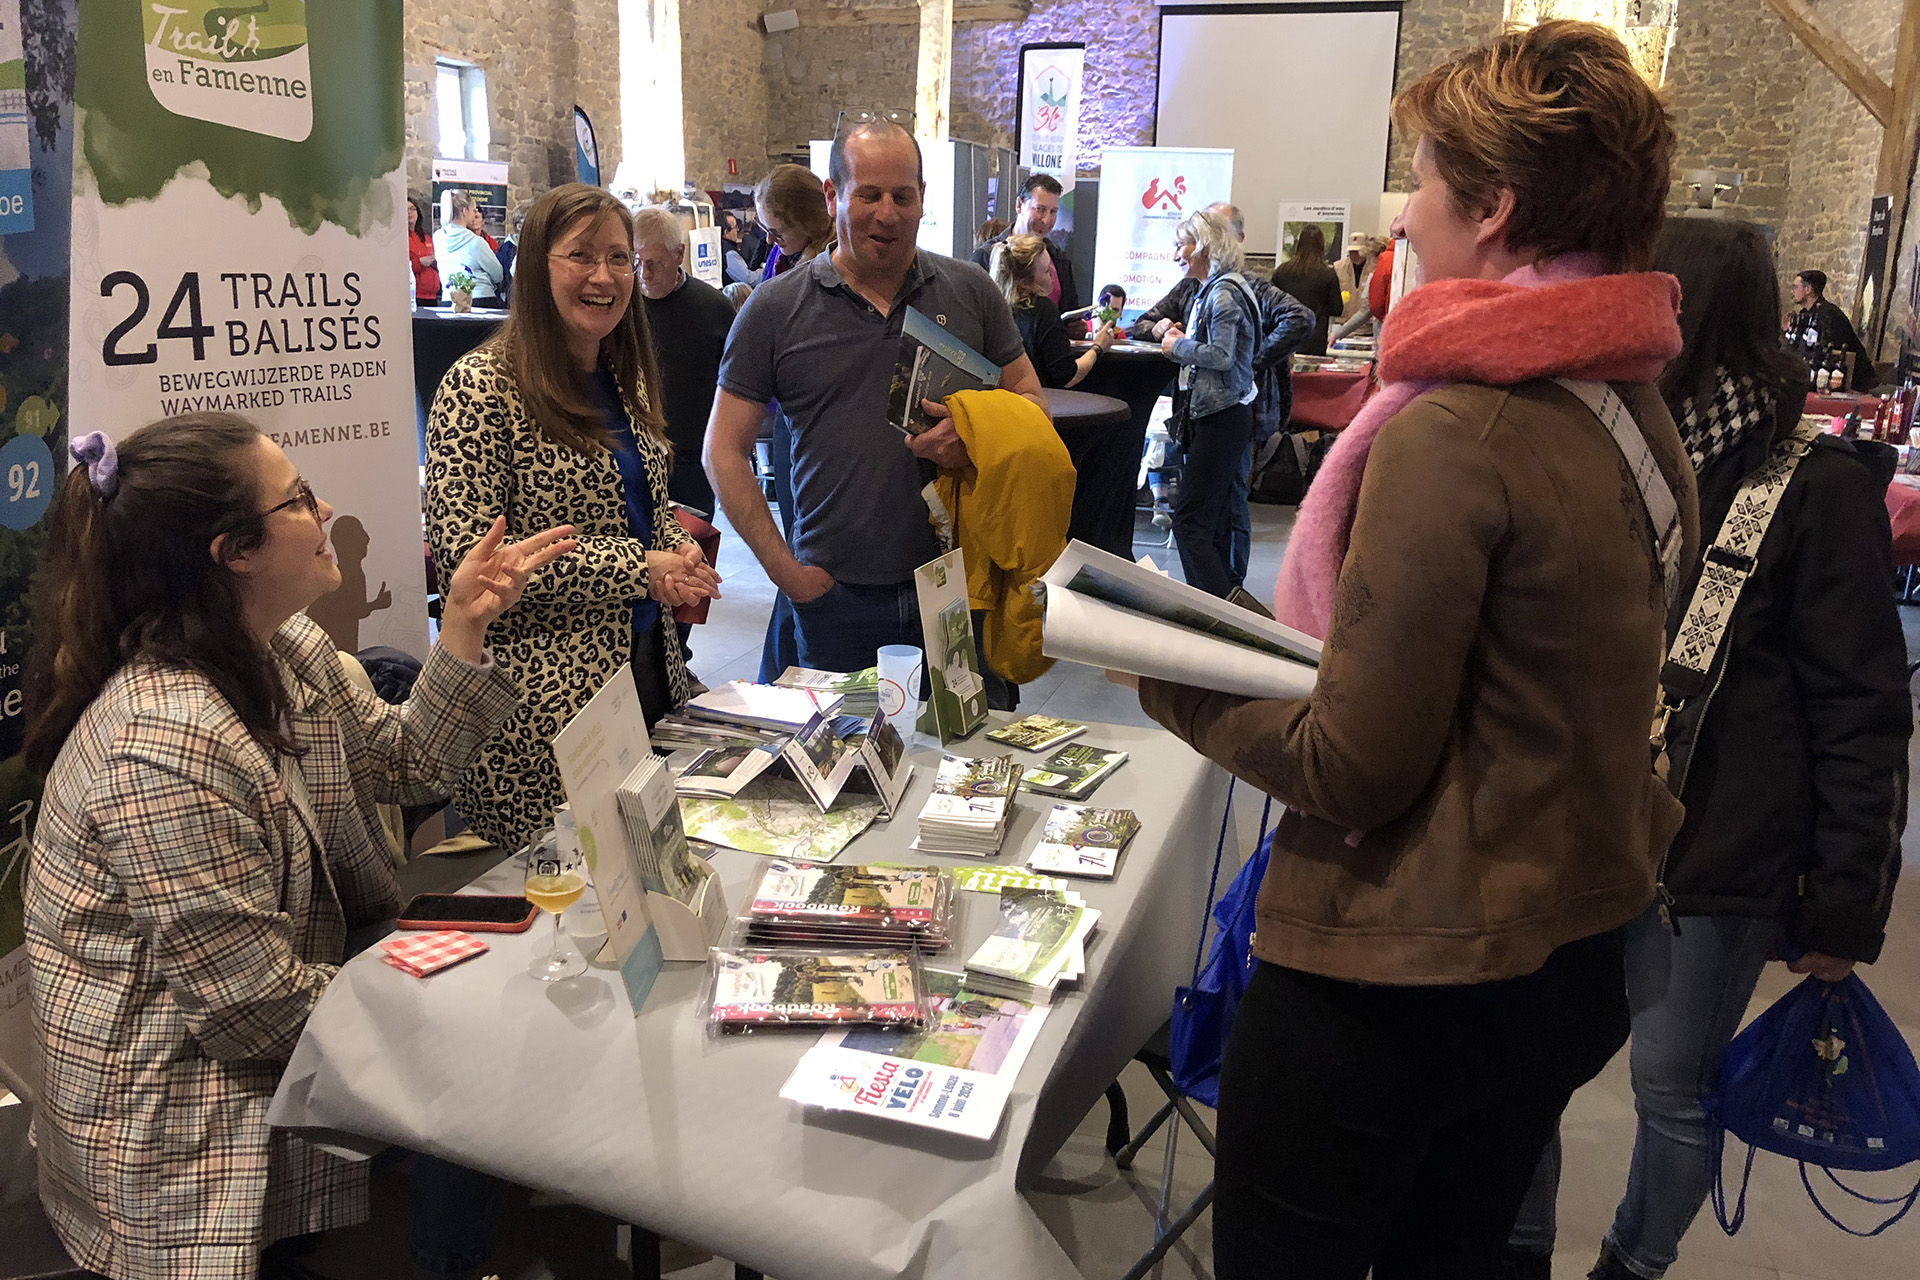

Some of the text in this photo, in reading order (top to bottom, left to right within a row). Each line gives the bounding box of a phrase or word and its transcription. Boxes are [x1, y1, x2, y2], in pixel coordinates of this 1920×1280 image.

[152, 59, 307, 99] en Famenne
[99, 270, 363, 367] 24 TRAILS
[225, 308, 382, 357] BALISÉS
[159, 360, 388, 393] BEWEGWIJZERDE PADEN
[160, 384, 353, 417] WAYMARKED TRAILS
[265, 421, 391, 449] FAMENNE.BE
[8, 461, 41, 502] 92
[772, 900, 861, 914] Roadbook
[736, 1002, 840, 1015] Roadbook
[854, 1062, 900, 1106] Fiesta
[886, 1067, 924, 1109] VÉLO
[958, 1082, 976, 1099] 2024
